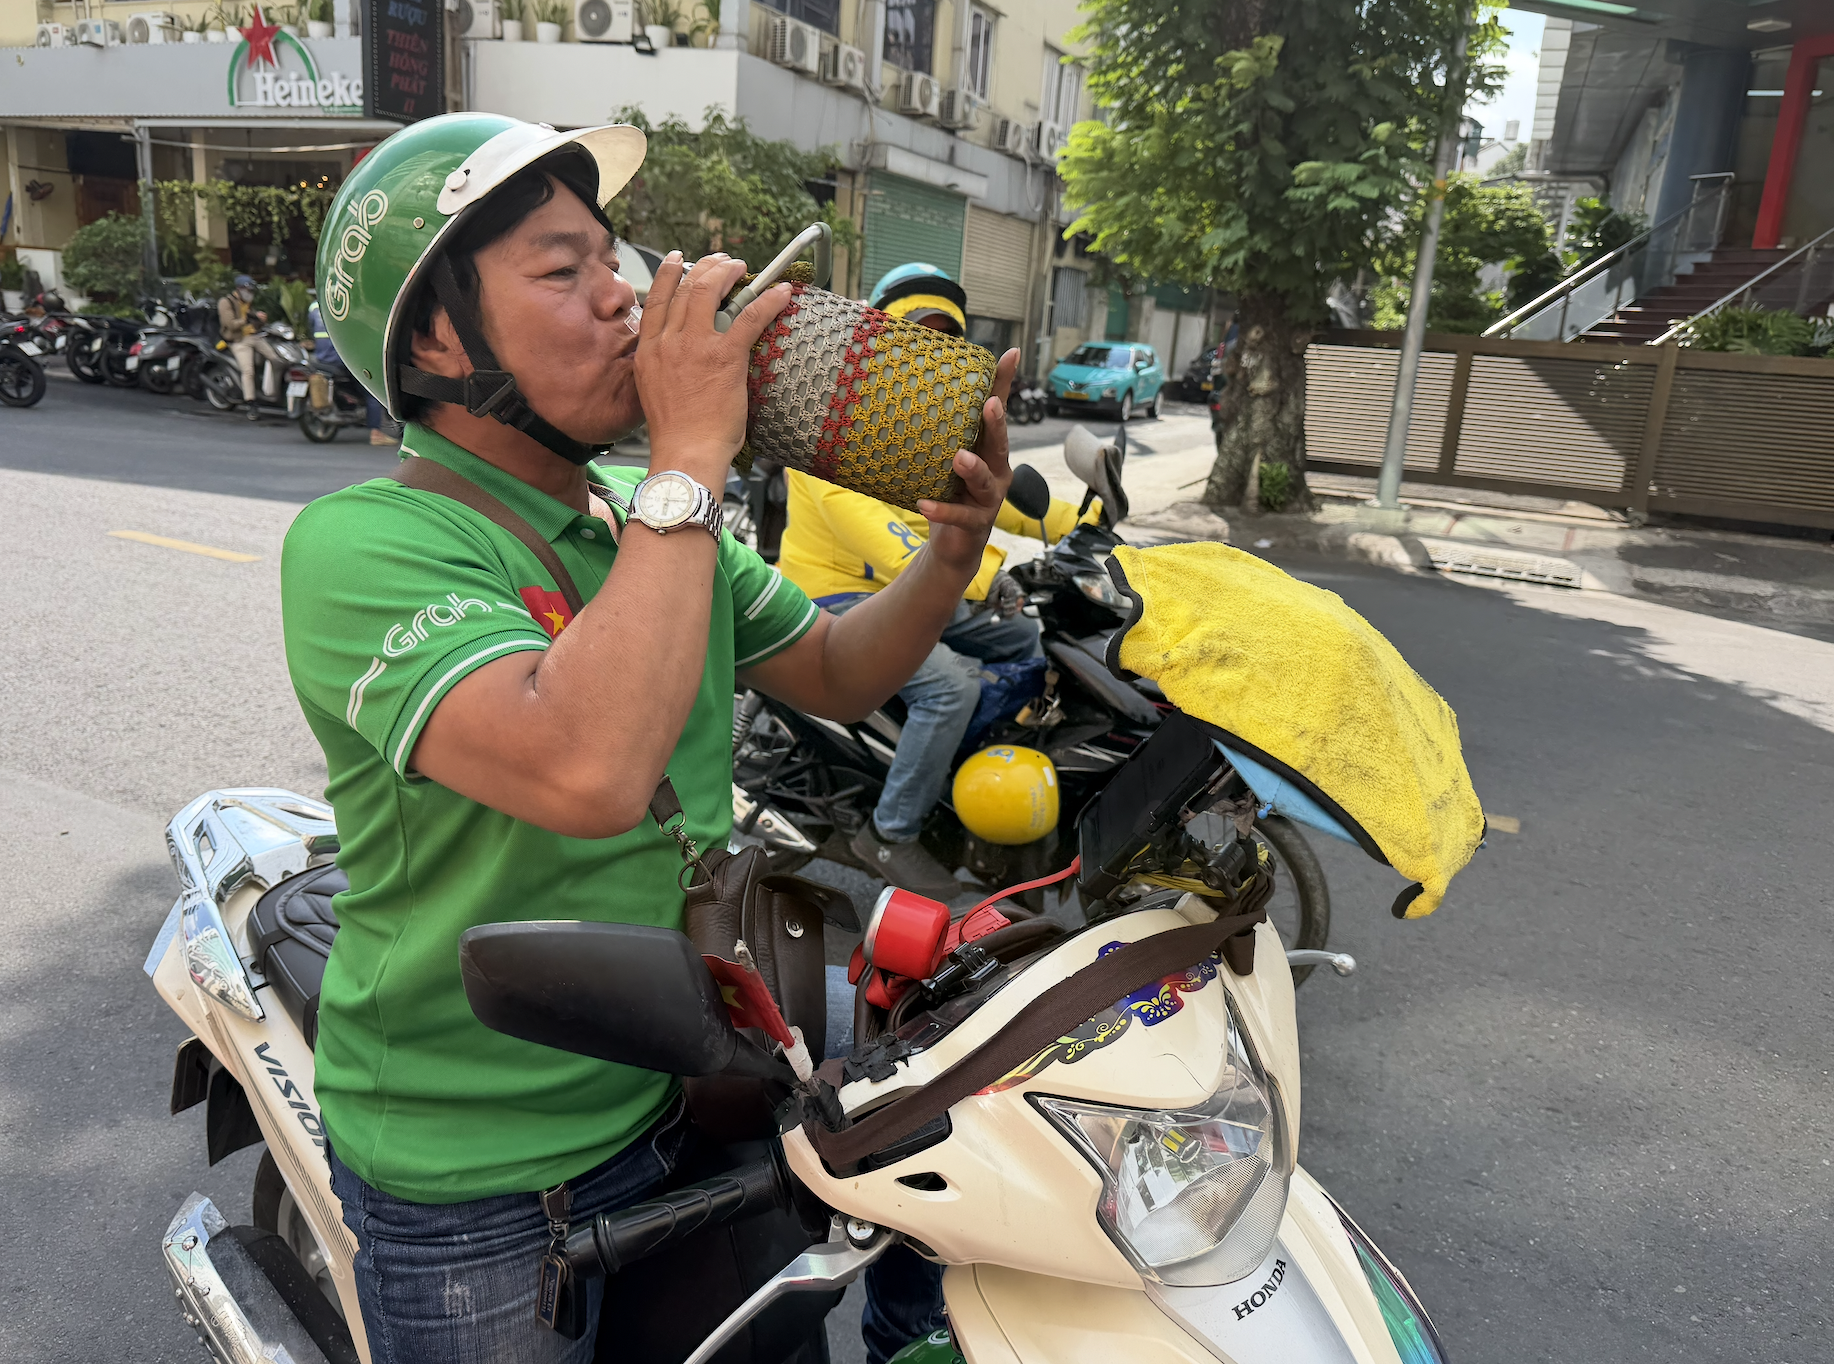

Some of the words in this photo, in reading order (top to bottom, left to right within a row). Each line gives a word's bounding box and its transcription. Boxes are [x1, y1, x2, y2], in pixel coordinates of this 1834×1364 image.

[253, 71, 363, 106] Heineke
[325, 189, 388, 321] Grab
[382, 592, 492, 657] Grab
[1231, 1258, 1287, 1321] HONDA
